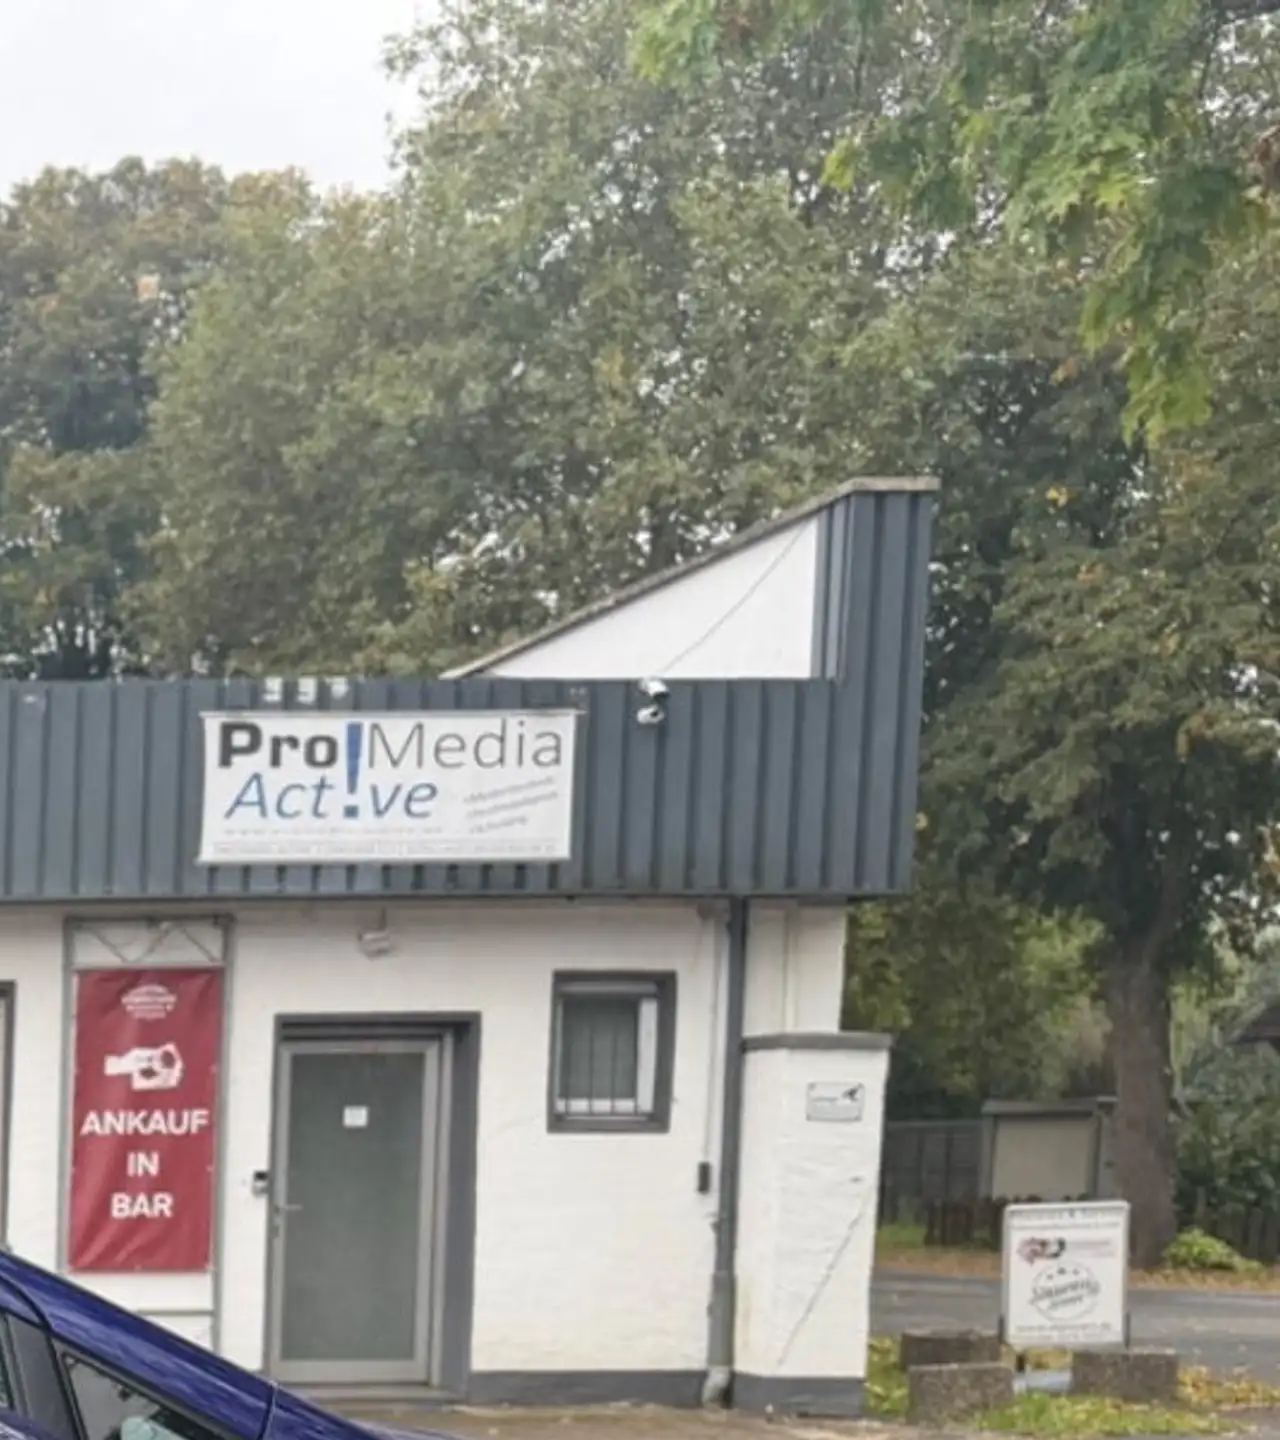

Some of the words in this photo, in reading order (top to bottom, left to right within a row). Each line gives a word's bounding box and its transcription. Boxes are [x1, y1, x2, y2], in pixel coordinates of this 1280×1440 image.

[80, 1109, 210, 1136] ANKAUF
[127, 1151, 159, 1177] IN
[109, 1192, 174, 1219] BAR
